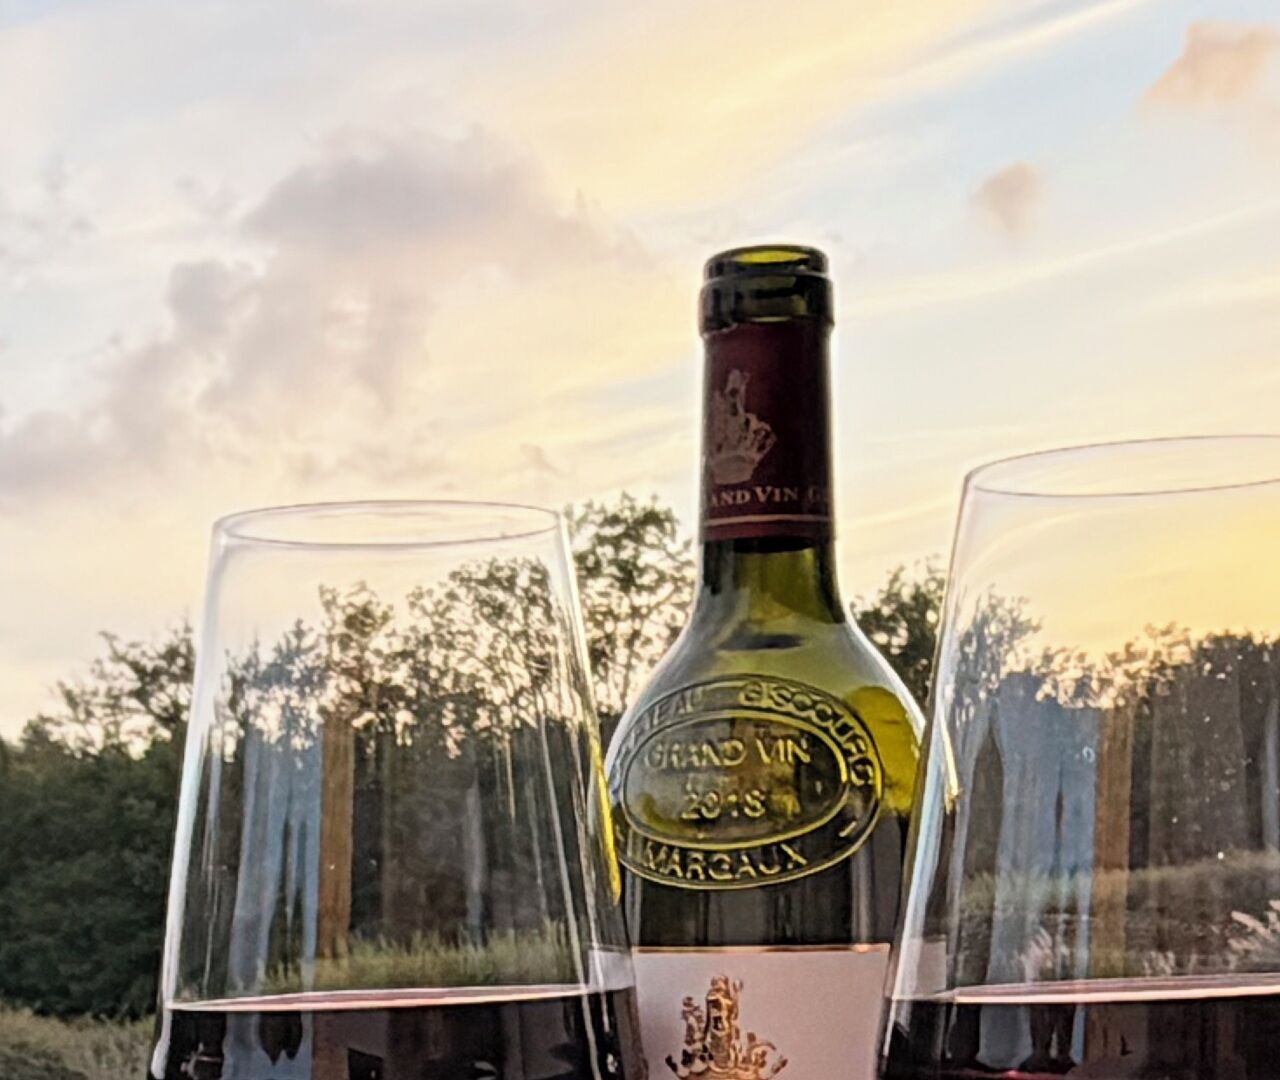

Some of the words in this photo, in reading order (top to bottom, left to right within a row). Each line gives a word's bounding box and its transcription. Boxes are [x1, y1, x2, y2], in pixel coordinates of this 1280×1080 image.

[710, 488, 751, 507] AND
[753, 485, 799, 503] VIN
[644, 738, 747, 770] GRAND
[755, 735, 812, 765] VIN
[644, 842, 808, 882] MARGAUX
